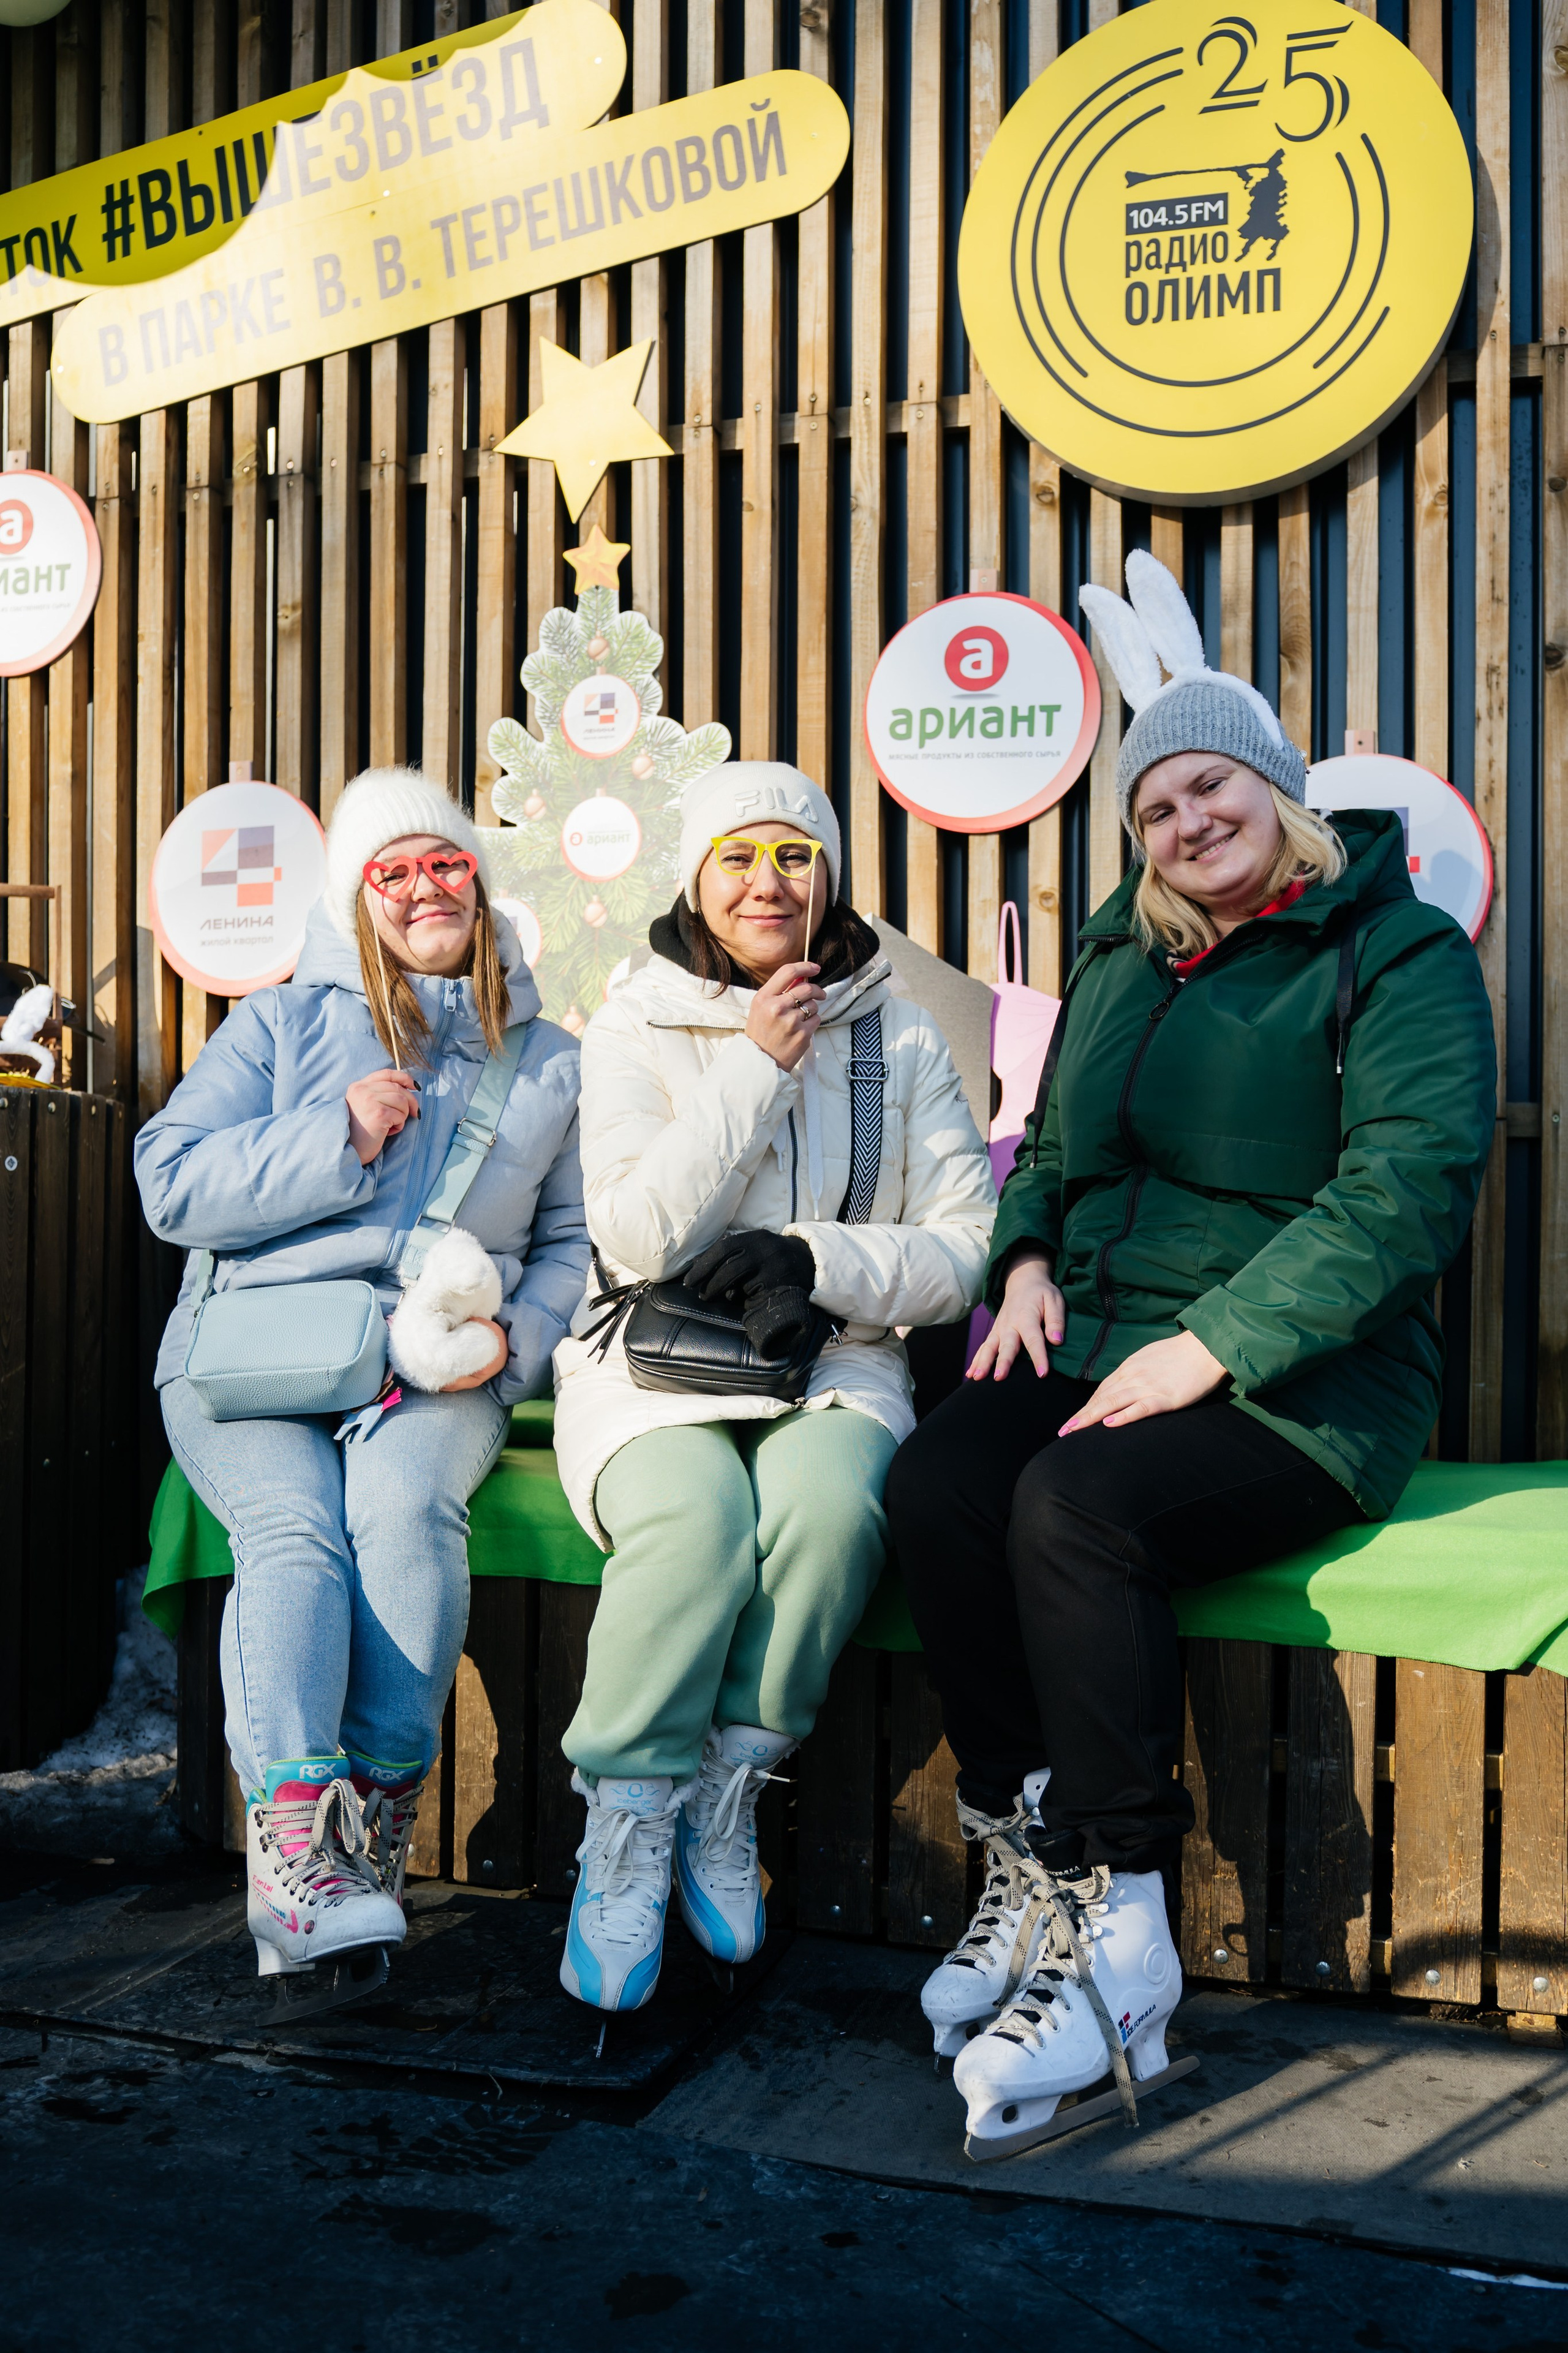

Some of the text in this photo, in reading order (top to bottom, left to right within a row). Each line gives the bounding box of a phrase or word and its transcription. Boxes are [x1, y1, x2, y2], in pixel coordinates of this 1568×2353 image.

[0, 17, 1354, 295] ТОК #ВЫШЕЗВЁЗД 25
[98, 97, 788, 388] В ПАРКЕ В. В. ТЕРЕШКОВОЙ
[1125, 230, 1229, 278] радио
[1125, 268, 1282, 326] ОЛИМП
[889, 704, 1062, 749] ариант
[735, 787, 818, 823] FILA
[200, 915, 274, 930] ЛЕНИНА
[300, 1763, 336, 1779] RGX
[369, 1767, 405, 1781] RGX
